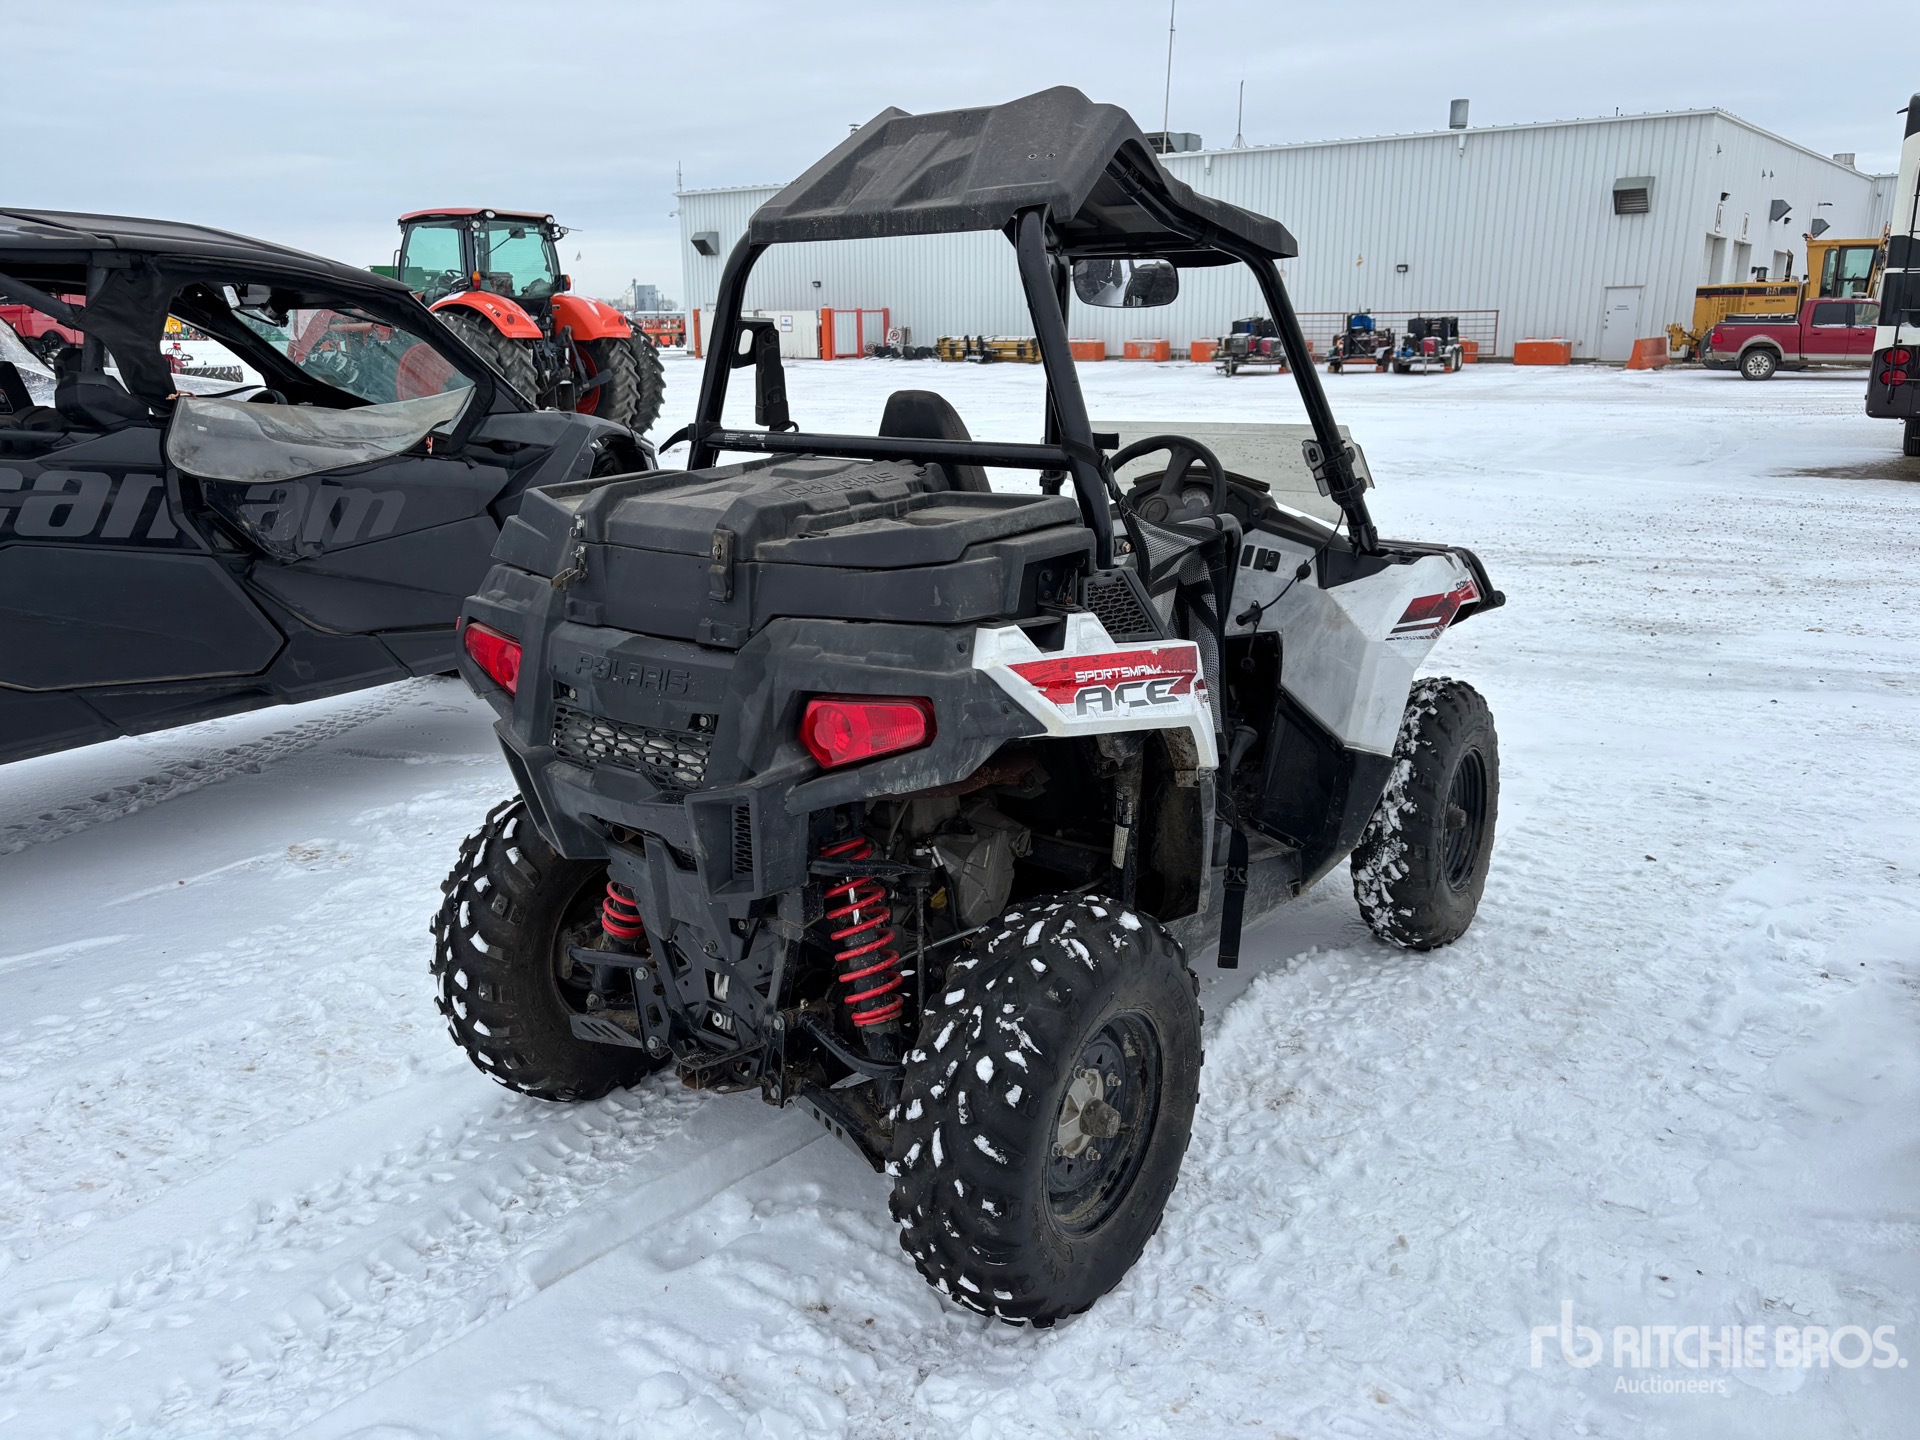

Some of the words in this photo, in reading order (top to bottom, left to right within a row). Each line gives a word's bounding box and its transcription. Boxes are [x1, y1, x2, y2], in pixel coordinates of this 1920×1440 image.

[782, 472, 901, 499] POLARIS
[575, 650, 692, 695] POLARIS
[1074, 676, 1181, 717] ACE
